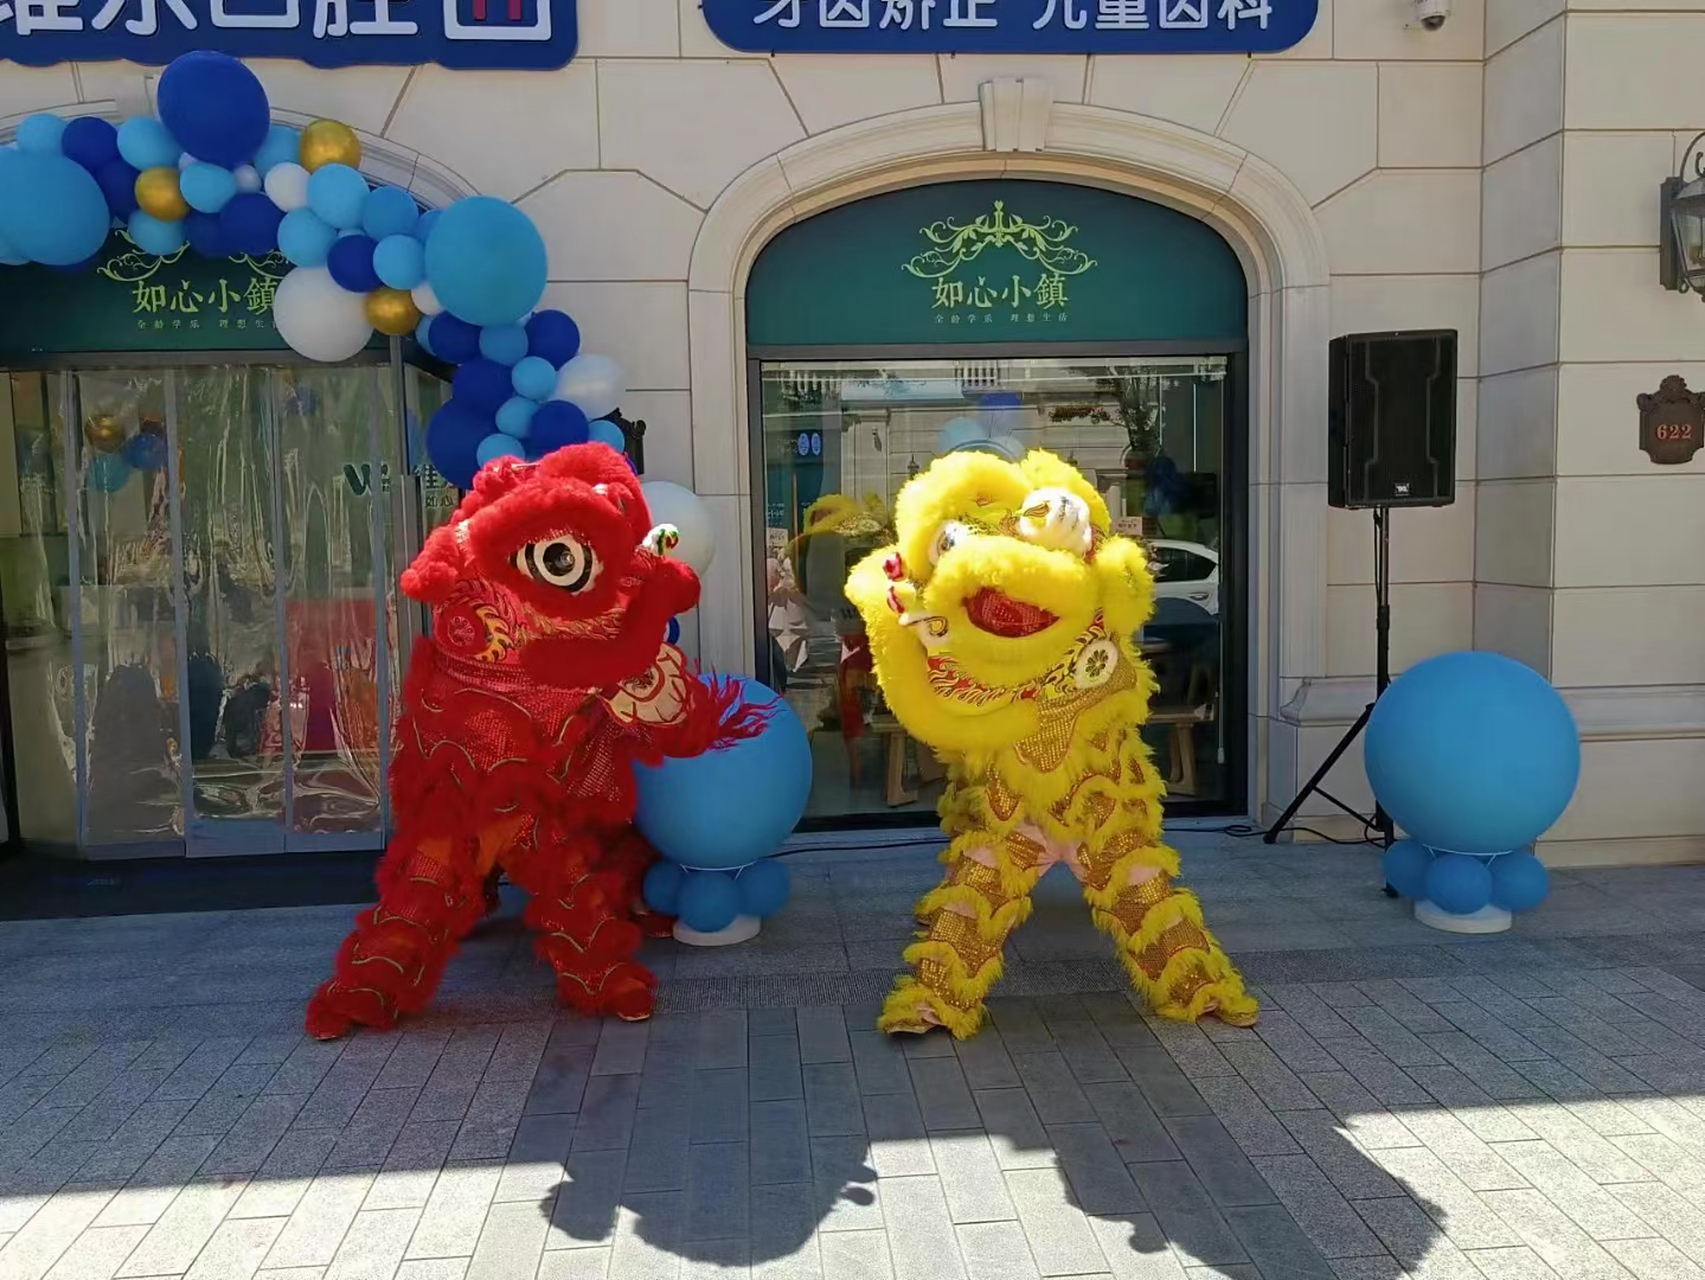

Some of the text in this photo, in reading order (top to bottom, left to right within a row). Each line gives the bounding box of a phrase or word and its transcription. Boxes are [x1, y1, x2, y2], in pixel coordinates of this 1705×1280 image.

[931, 273, 1069, 310] 如心小鎮
[1657, 424, 1692, 440] 622
